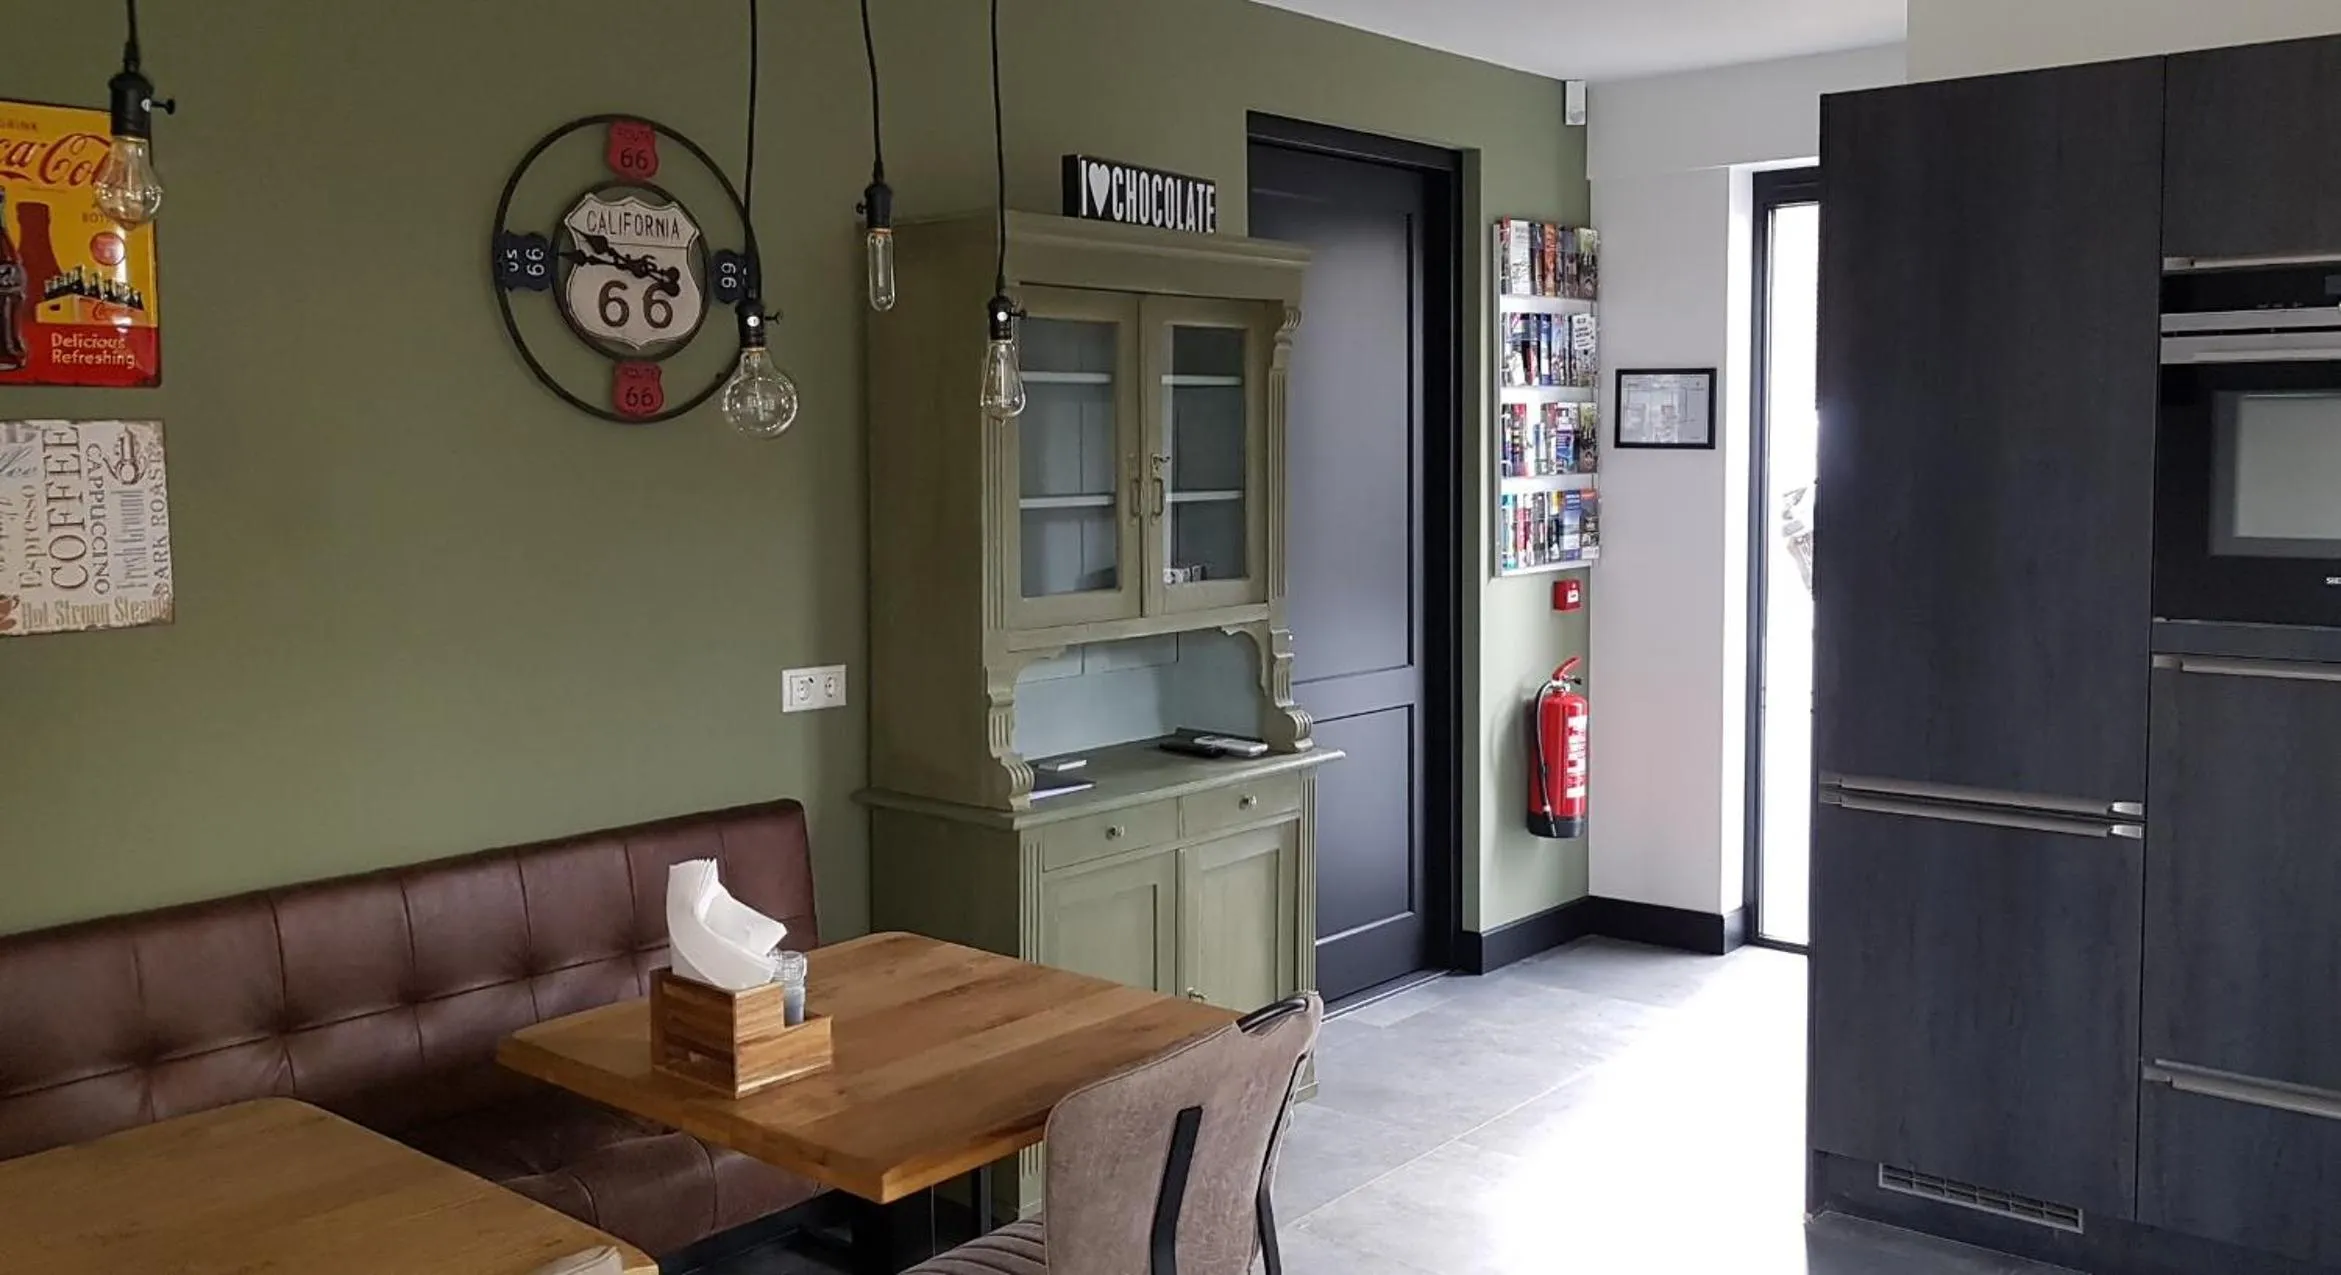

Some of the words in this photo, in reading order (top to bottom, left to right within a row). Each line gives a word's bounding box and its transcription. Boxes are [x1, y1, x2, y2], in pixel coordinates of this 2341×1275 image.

[620, 147, 649, 170] 66
[1081, 160, 1088, 216] I
[1112, 166, 1215, 234] CHOCOLATE
[586, 210, 681, 241] CALIFORNIA
[526, 247, 546, 277] 66
[720, 262, 737, 289] 66
[598, 280, 674, 330] 66
[51, 332, 126, 350] Delicious
[51, 348, 137, 370] Refreshing
[624, 386, 654, 408] 66
[41, 427, 89, 590] COFFEE
[86, 442, 111, 595] CAPPUCCINO
[19, 484, 48, 589] Espresso
